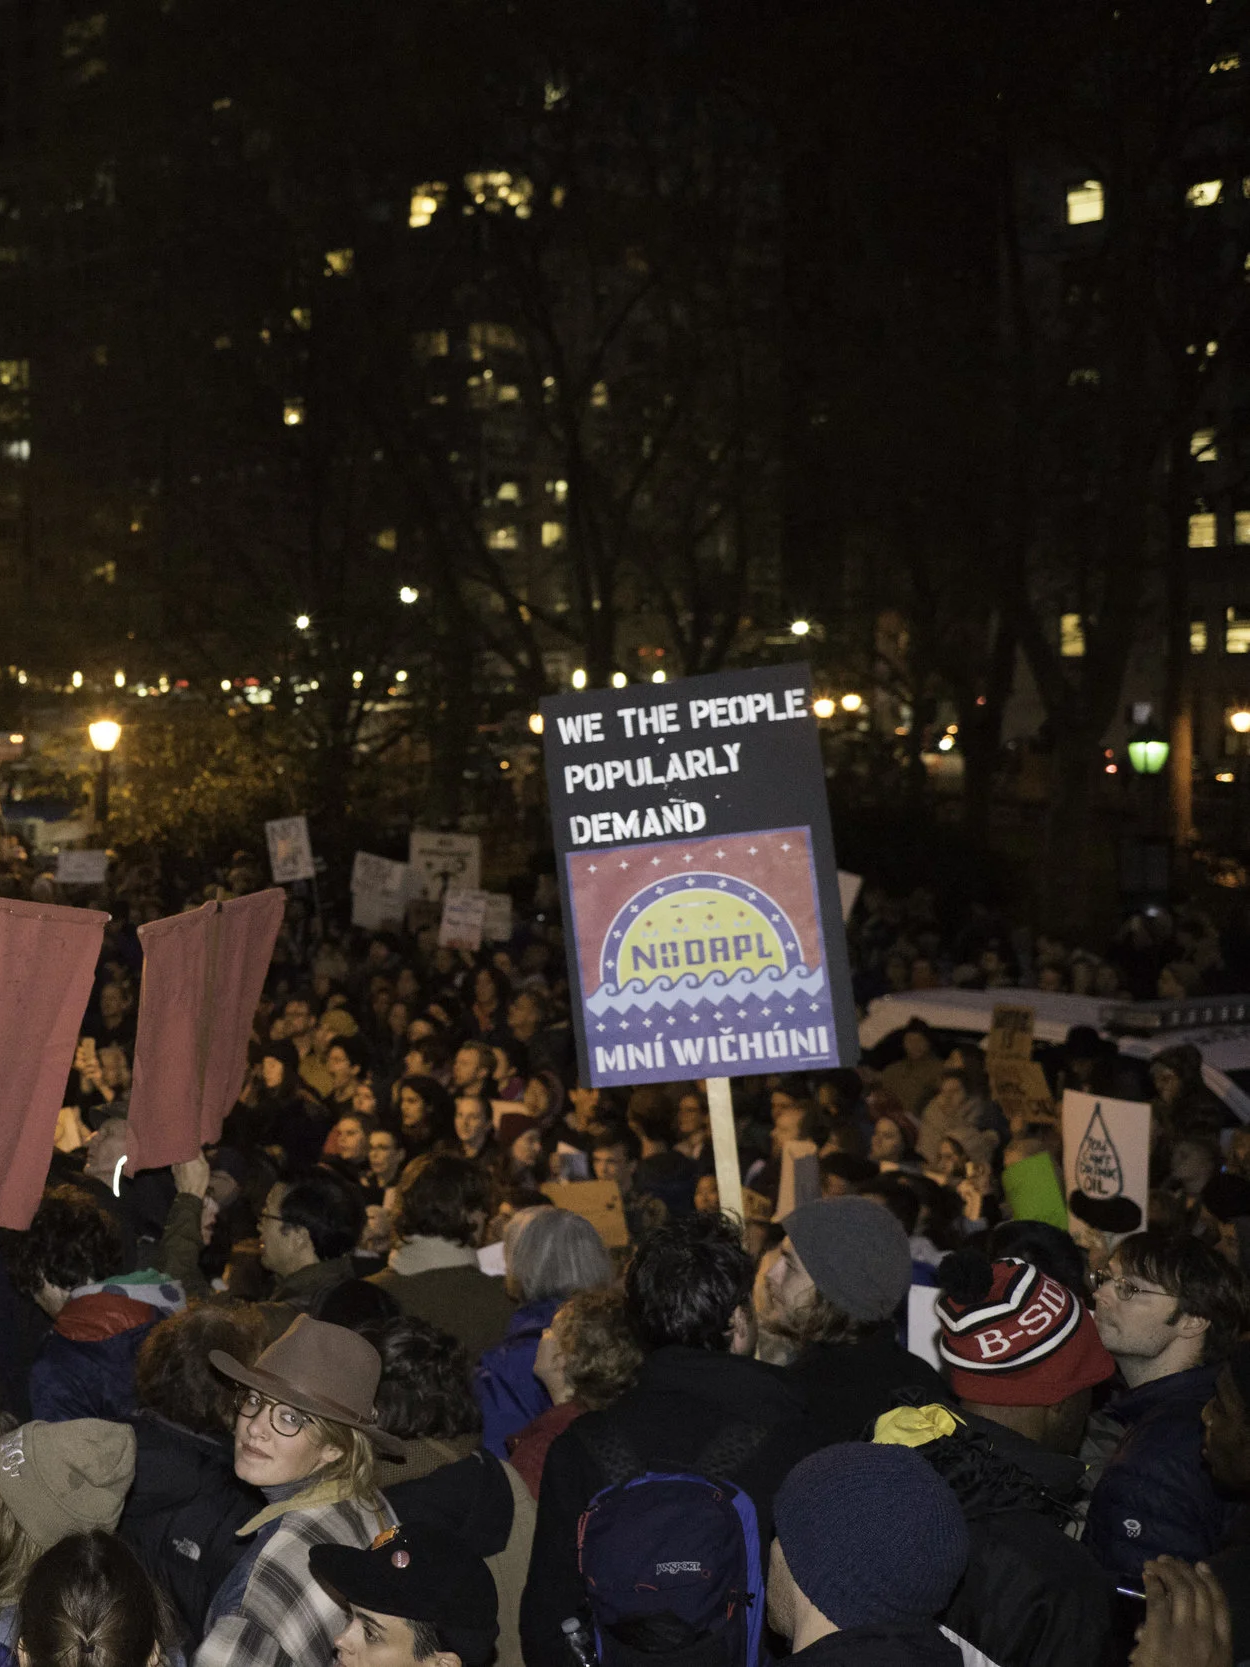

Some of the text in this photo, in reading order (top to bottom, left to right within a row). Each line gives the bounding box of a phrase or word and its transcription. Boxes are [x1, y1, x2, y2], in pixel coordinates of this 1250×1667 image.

[557, 688, 808, 745] WE THE PEOPLE
[564, 742, 741, 793] POPULARLY
[569, 801, 707, 845] DEMAND
[595, 1021, 830, 1073] MNÍ WIČHÓNI
[1083, 1175, 1109, 1194] OIL
[974, 1274, 1066, 1359] B-SID
